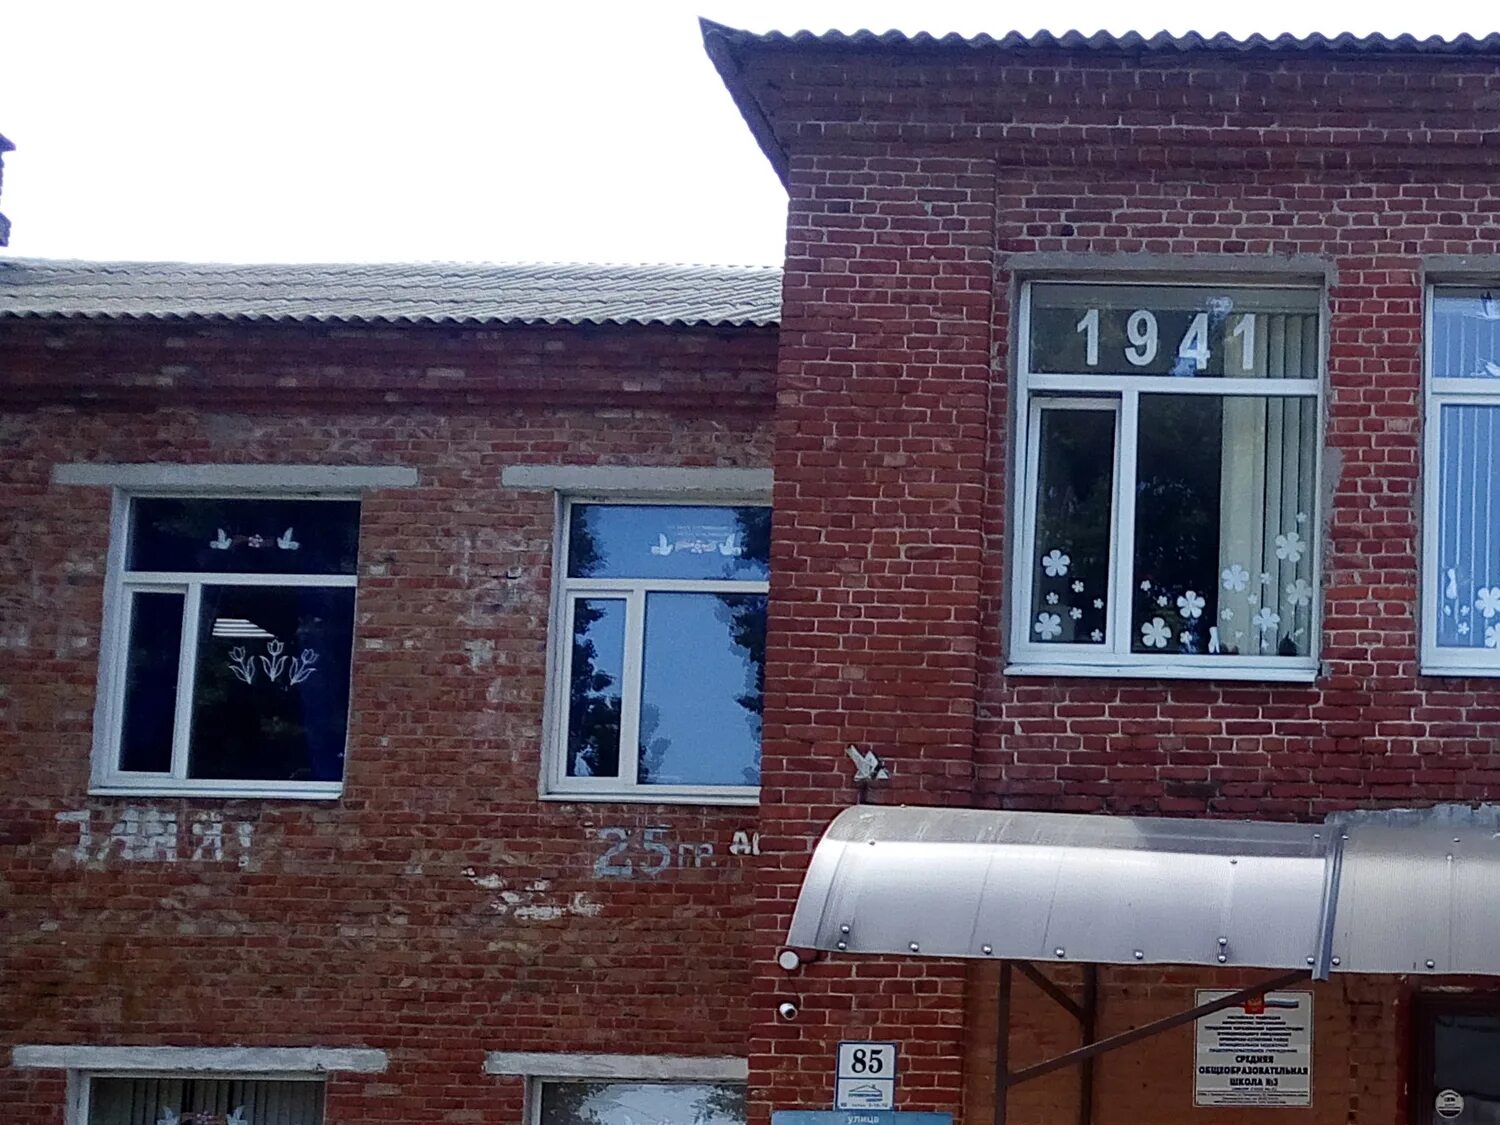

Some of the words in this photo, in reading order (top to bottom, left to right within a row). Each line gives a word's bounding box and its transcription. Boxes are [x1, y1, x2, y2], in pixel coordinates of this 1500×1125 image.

[1076, 308, 1256, 370] 1941
[850, 1048, 884, 1074] 85
[1235, 1055, 1274, 1065] СРЕДНЯЯ
[1198, 1066, 1308, 1076] ОБЩЕОБРАЗОВАТЕЛЬНАЯ
[1229, 1077, 1263, 1086] ШКОЛА
[846, 1115, 880, 1125] улица
